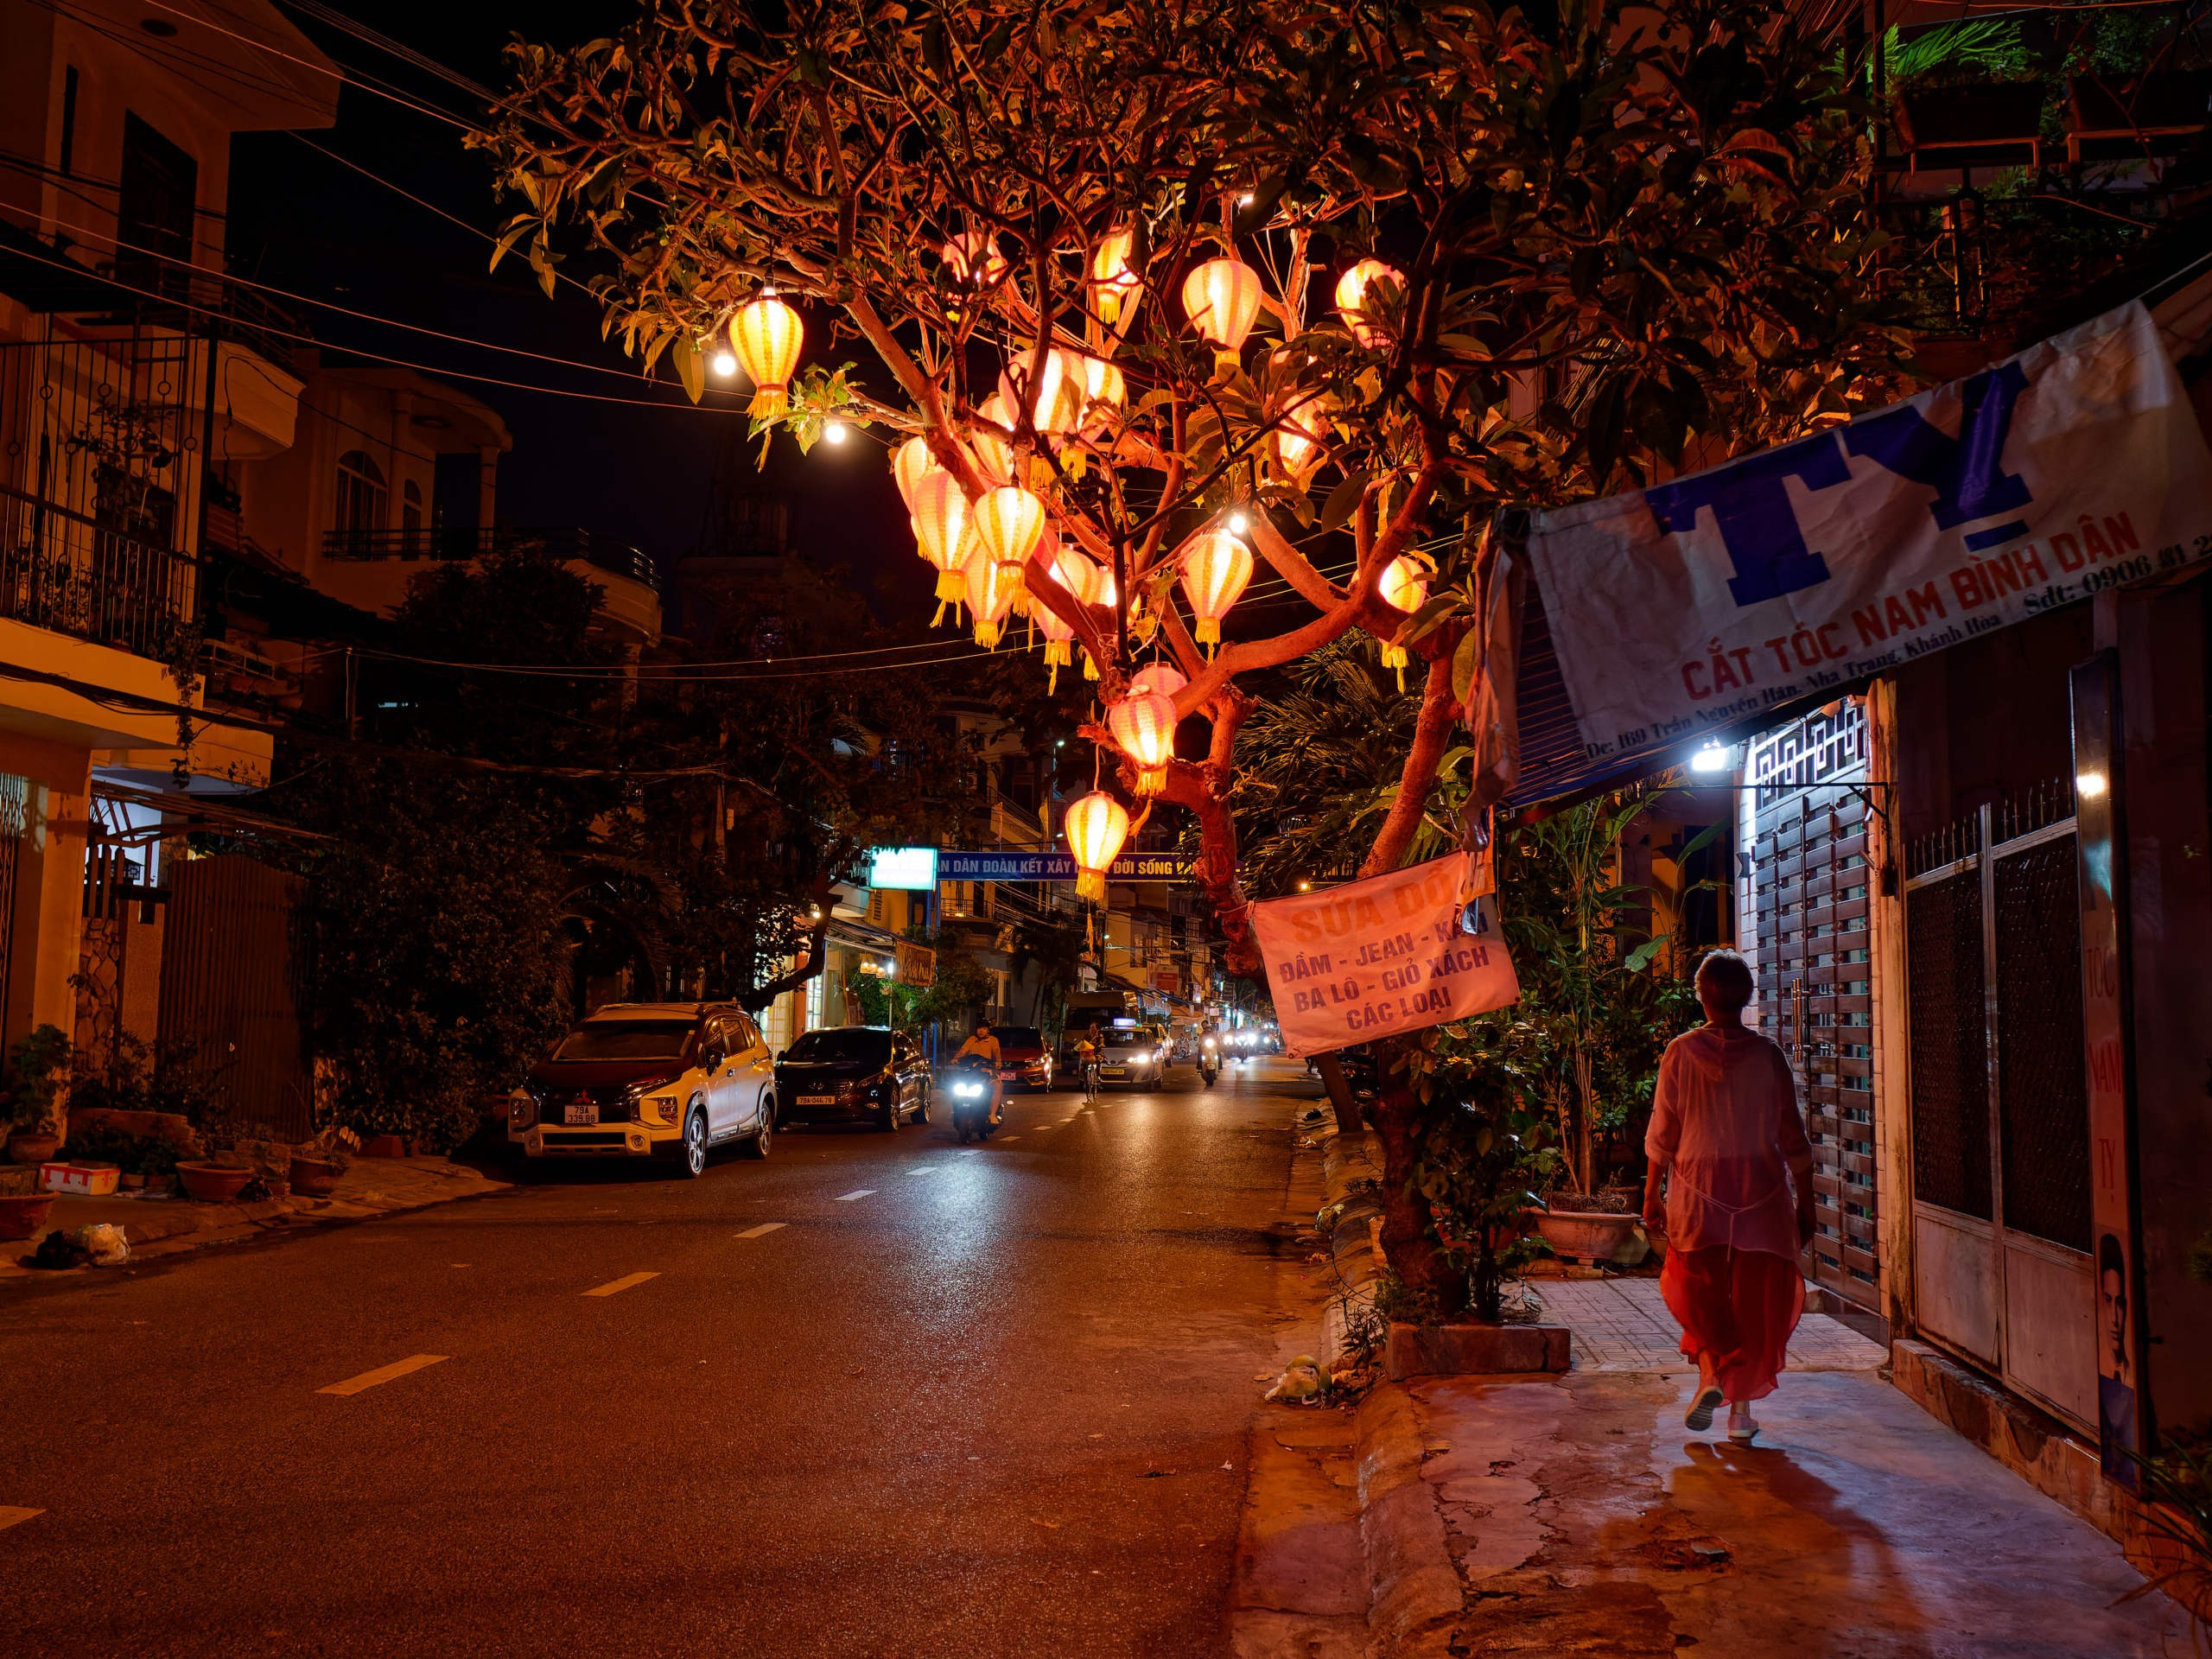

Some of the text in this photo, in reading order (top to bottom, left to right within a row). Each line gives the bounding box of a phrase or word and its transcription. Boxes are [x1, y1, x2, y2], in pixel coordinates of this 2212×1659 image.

[2082, 555, 2152, 594] 0906
[2193, 532, 2212, 556] 2
[1681, 512, 2140, 702] CẮT TÓC NAM BÌNH DÂN
[1618, 728, 1646, 750] 169
[1806, 669, 1840, 690] Nha
[1904, 626, 1962, 658] Khánh
[954, 858, 978, 873] DÂN
[983, 858, 1016, 873] ĐOÀN
[1019, 857, 1043, 873] KẾT
[1047, 858, 1071, 873] XÂY
[1114, 858, 1135, 874] ĐỜI
[1138, 858, 1173, 875] SỐNG
[1292, 892, 1384, 943] SỬA
[1279, 951, 1332, 983] ĐẦM
[1356, 932, 1415, 967] JEAN
[1294, 988, 1326, 1014] BA
[1332, 976, 1360, 1004] LÔ
[1382, 957, 1421, 992] GIỎ
[1427, 946, 1491, 979] XÁCH
[1346, 987, 1452, 1031] CÁC LOẠI
[2088, 1042, 2121, 1094] NAM
